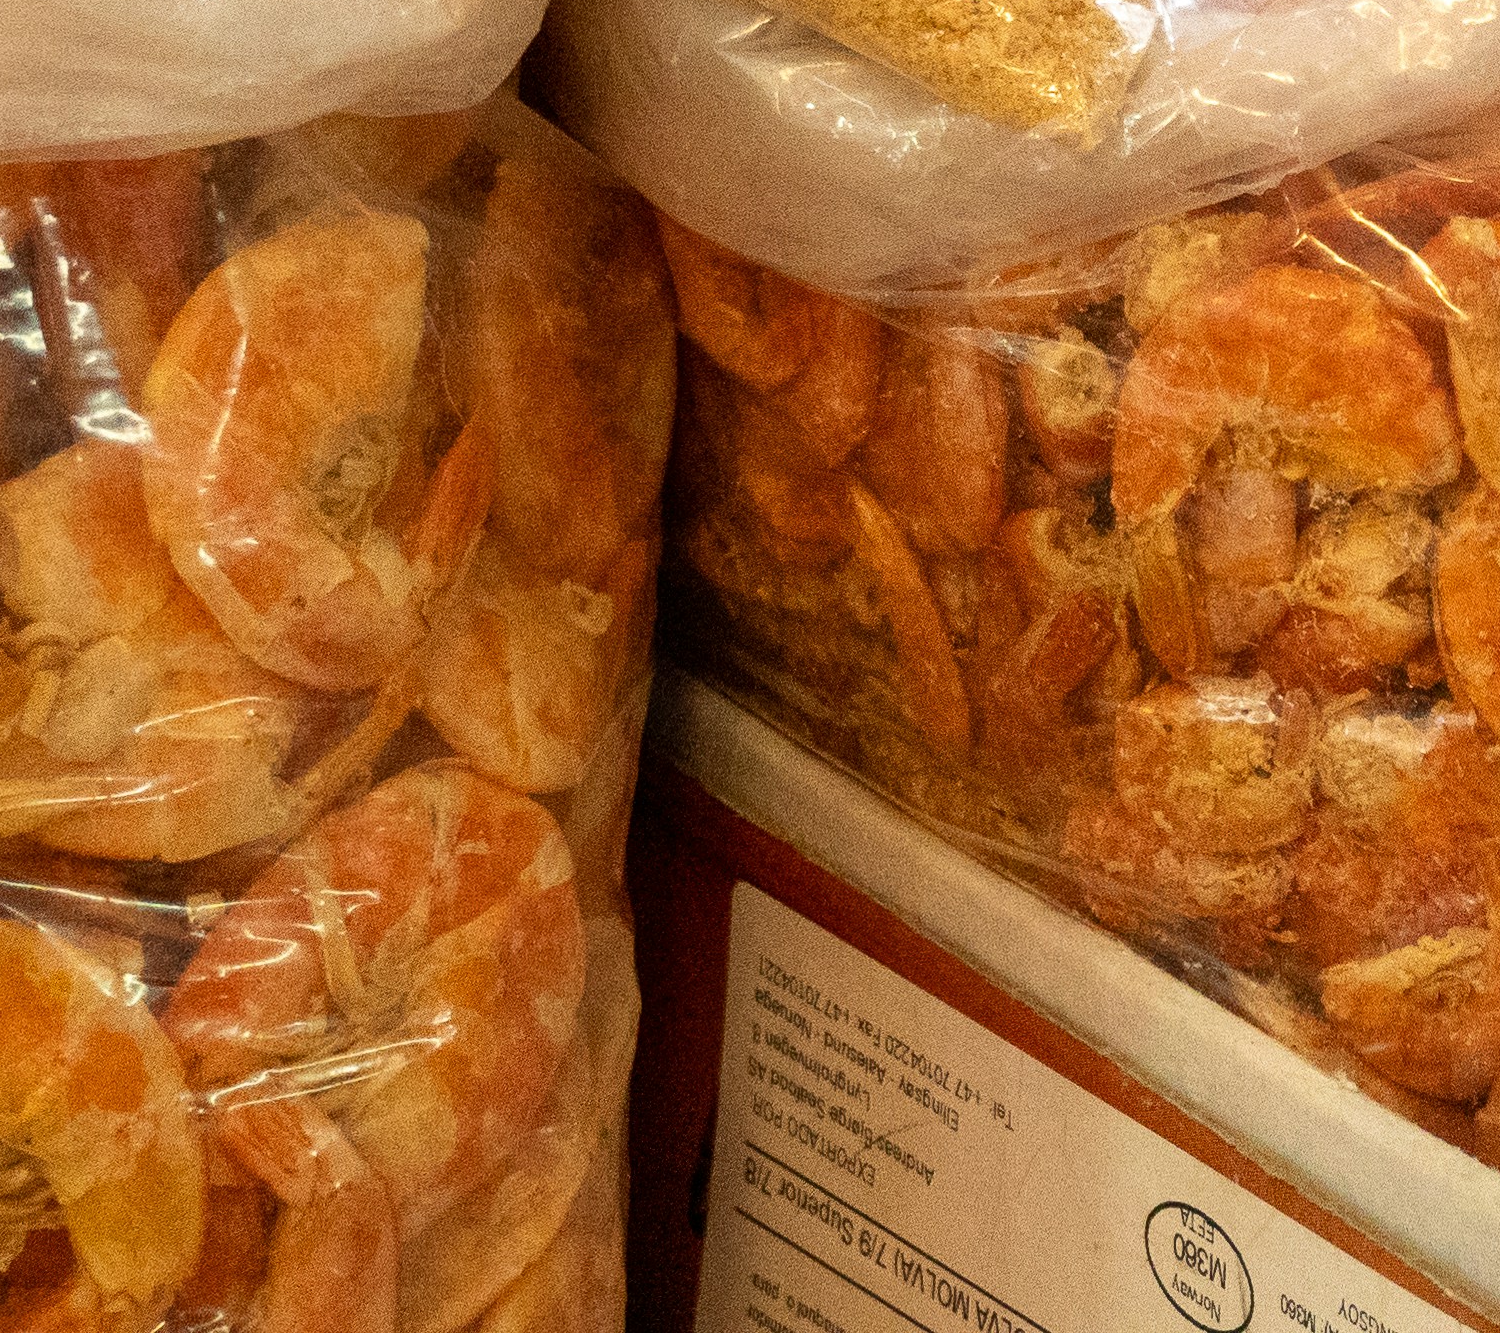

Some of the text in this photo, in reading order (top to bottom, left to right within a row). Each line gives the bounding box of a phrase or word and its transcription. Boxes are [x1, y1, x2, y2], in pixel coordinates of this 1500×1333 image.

[748, 1055, 767, 1081] AS
[787, 1117, 876, 1188] EXPORTADO
[743, 1155, 772, 1198] 7/8
[777, 1177, 855, 1247] Superior
[1179, 1207, 1216, 1245] EFTA
[858, 1228, 887, 1270] 7/9
[1172, 1232, 1227, 1291] M360
[1171, 1272, 1222, 1324] Norway
